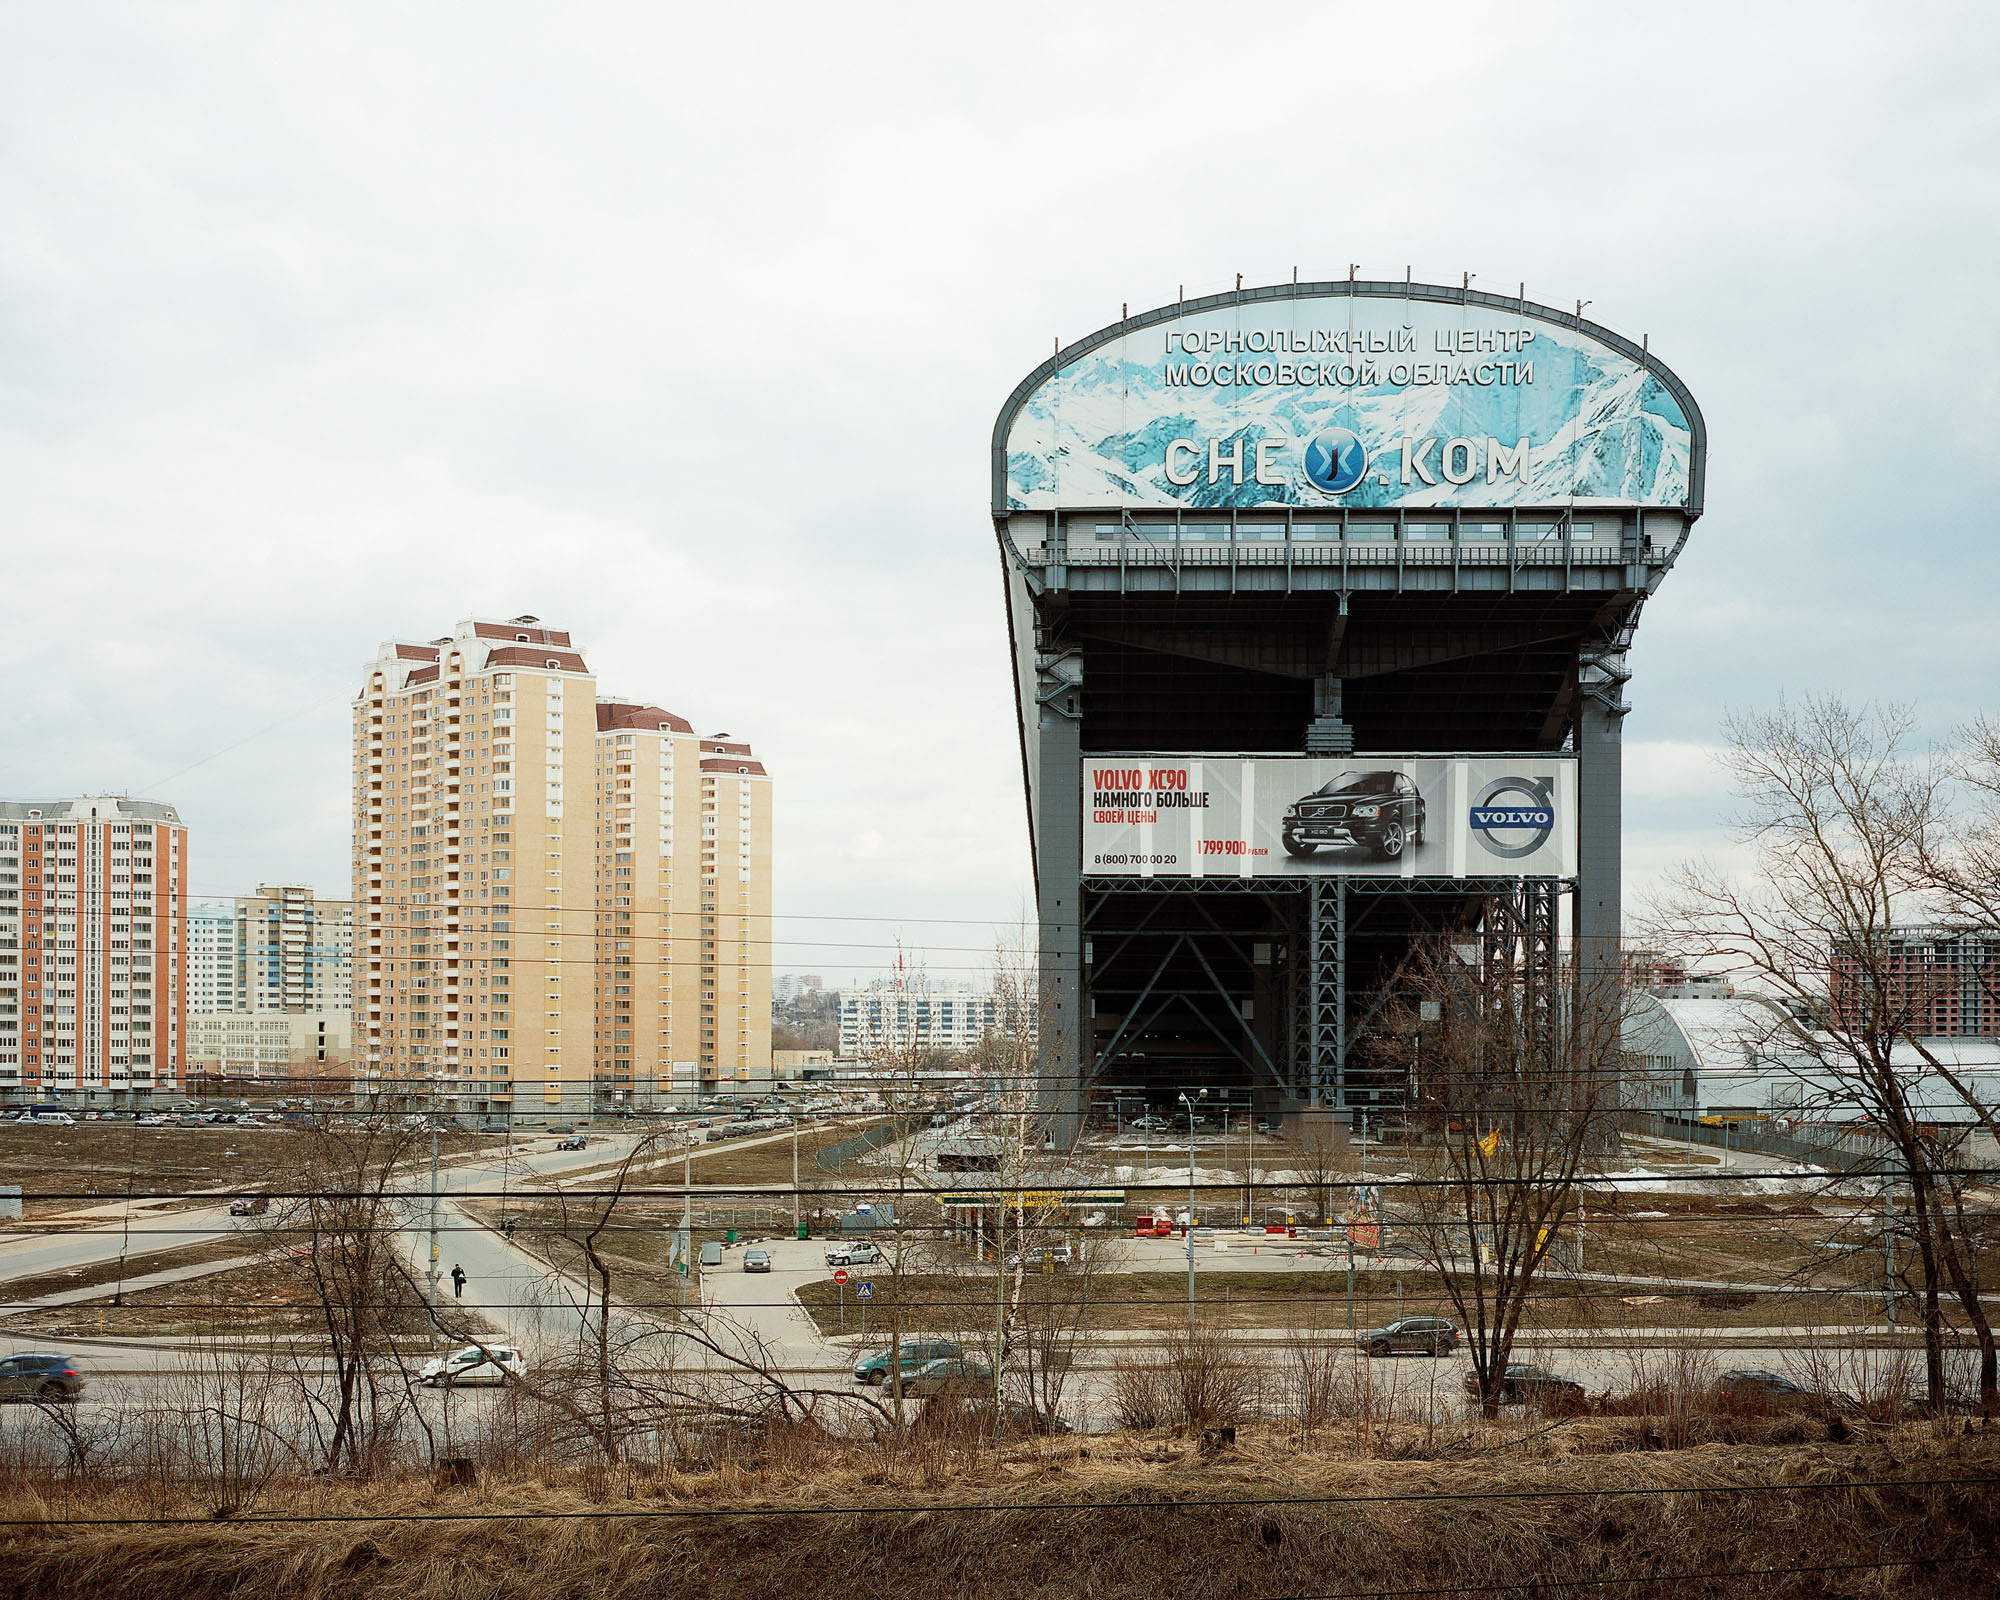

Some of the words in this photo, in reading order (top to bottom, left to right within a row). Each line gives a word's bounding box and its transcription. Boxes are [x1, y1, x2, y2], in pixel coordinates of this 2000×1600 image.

[1166, 323, 1418, 354] ГОРНОЛЫЖНЫЙ
[1435, 328, 1536, 357] ЦЕНТР
[1165, 359, 1381, 387] МОСКОВСКОЙ
[1389, 360, 1534, 386] ОБЛАСТИ
[1093, 769, 1142, 790] VOLVO
[1148, 769, 1187, 790] XC90
[1093, 792, 1152, 808] НАМНОГО
[1156, 792, 1209, 808] БОЛЬШЕ
[1093, 809, 1125, 823] СВОЕЙ
[1127, 810, 1157, 825] ЦЕНЫ
[1474, 812, 1549, 824] VOLVO
[1225, 840, 1247, 855] 900
[1247, 848, 1269, 856] РУБЛЕЙ
[1094, 854, 1101, 864] 8
[1102, 853, 1128, 865] (800)
[1129, 854, 1148, 864] 700
[1149, 854, 1163, 864] 00
[1164, 854, 1177, 864] 20
